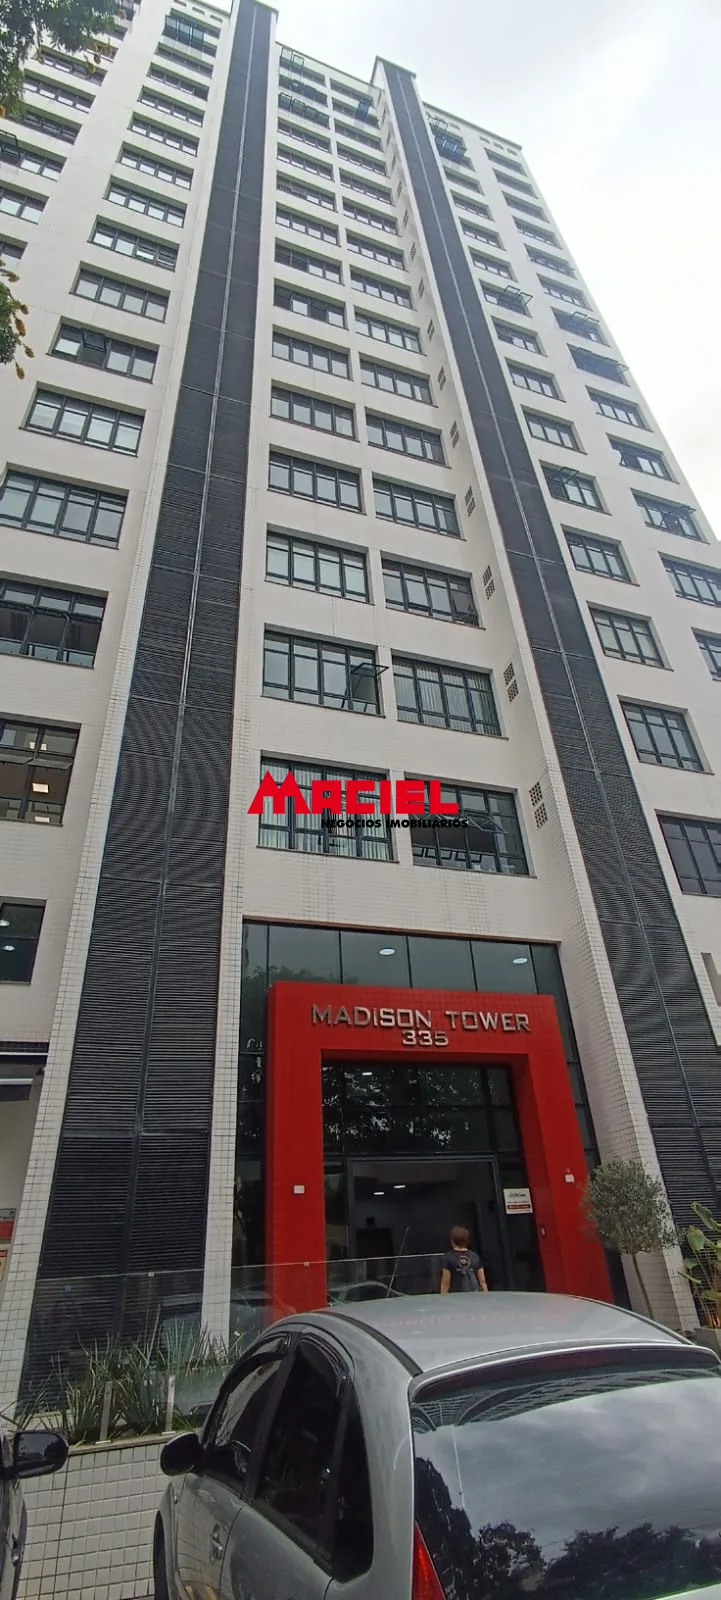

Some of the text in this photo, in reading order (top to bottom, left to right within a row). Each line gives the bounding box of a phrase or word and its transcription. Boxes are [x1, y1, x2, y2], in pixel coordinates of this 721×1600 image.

[312, 1004, 532, 1032] MADISON TOWER
[402, 1029, 449, 1046] 335
